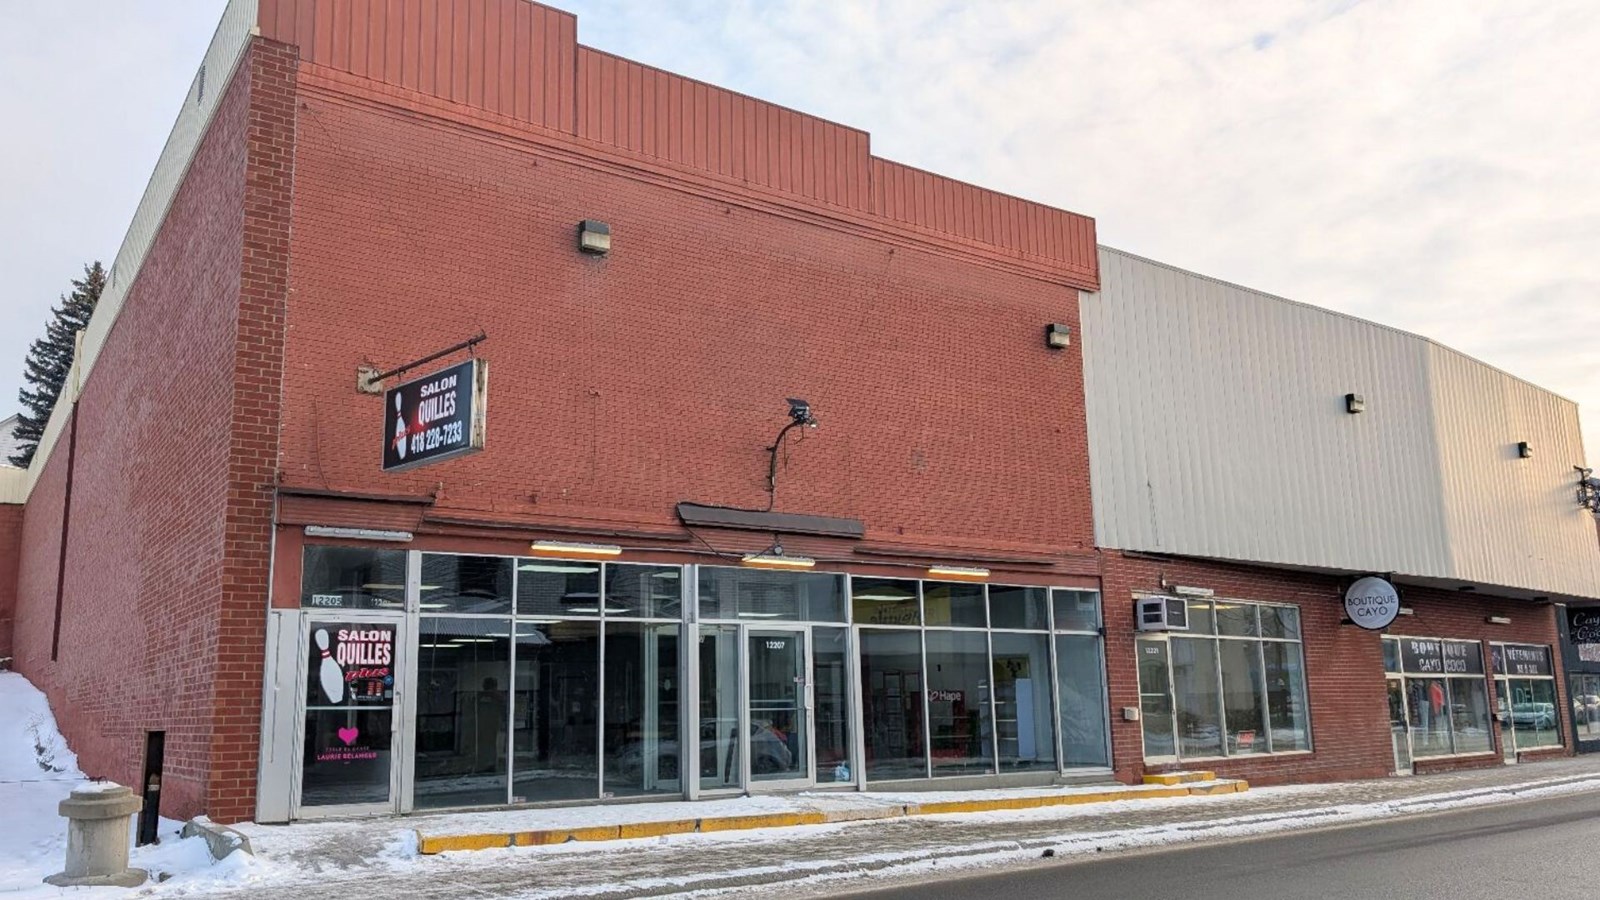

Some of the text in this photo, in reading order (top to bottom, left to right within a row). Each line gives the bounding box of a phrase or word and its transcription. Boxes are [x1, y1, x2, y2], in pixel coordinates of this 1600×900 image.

[420, 375, 457, 398] SALON
[418, 391, 457, 426] QUILLES
[410, 420, 463, 454] 418 228-7233
[312, 594, 342, 606] 12205
[1348, 594, 1396, 606] BOUTIQUE
[1357, 606, 1388, 617] CAYO
[338, 629, 392, 642] SALON
[766, 641, 785, 649] 12207
[1411, 641, 1467, 658] BOUTIQUE
[337, 642, 392, 667] QUILLES
[1419, 658, 1467, 672] CAYO COCO
[940, 690, 962, 702] Hape
